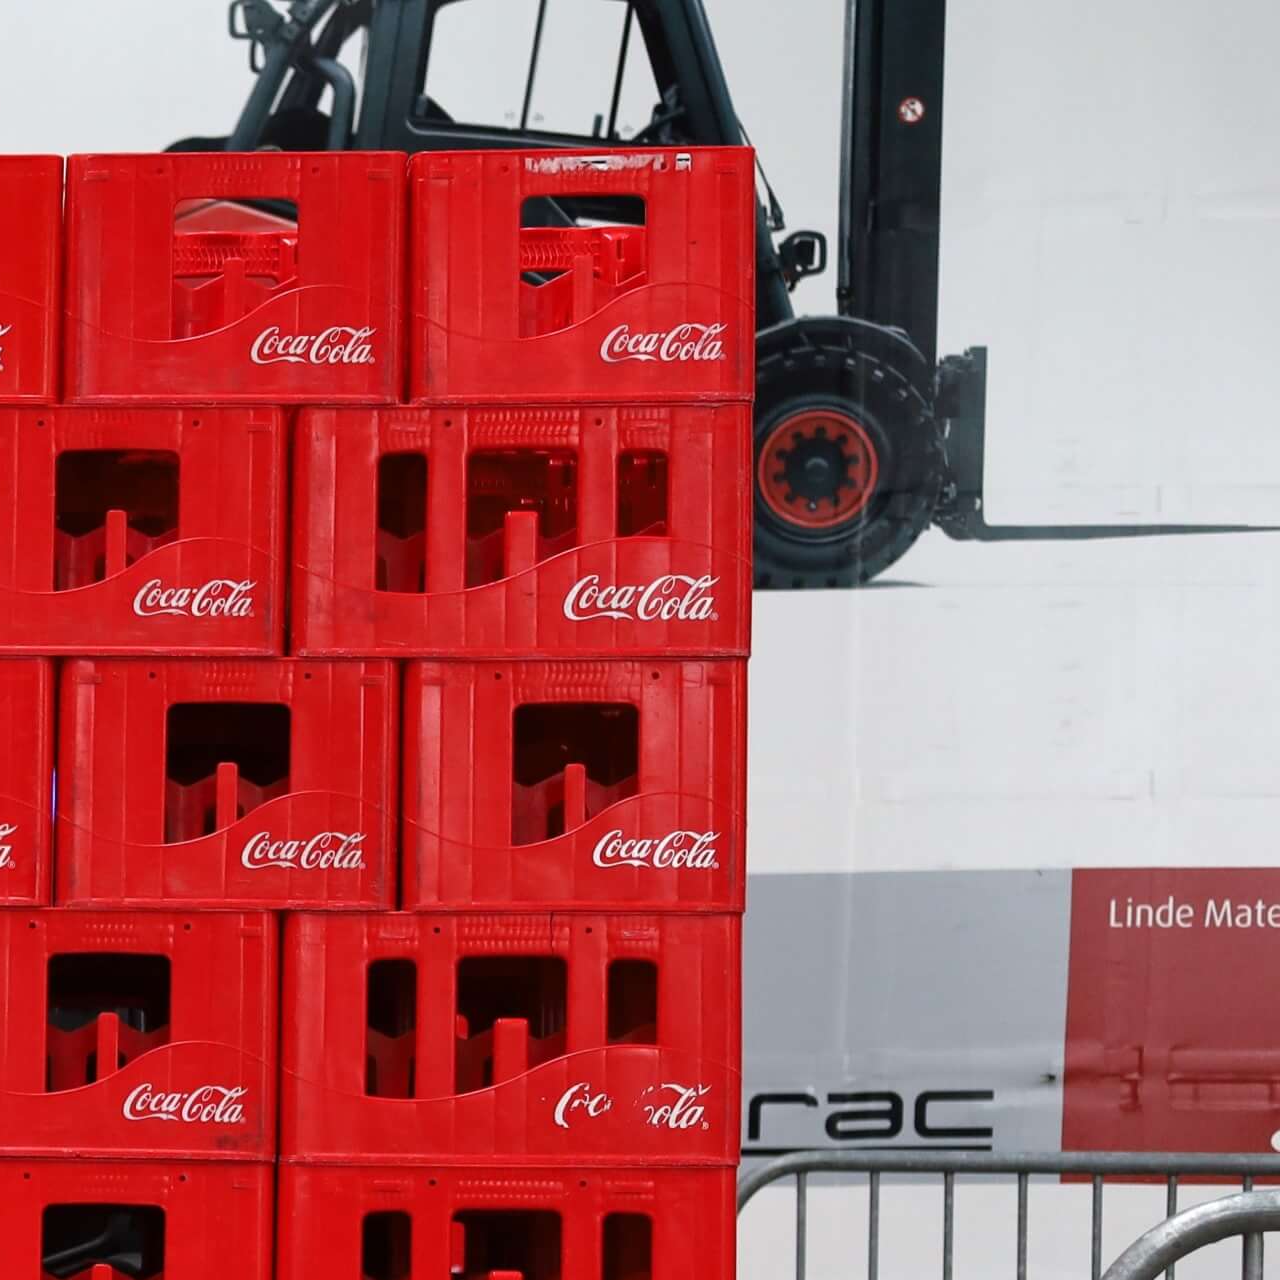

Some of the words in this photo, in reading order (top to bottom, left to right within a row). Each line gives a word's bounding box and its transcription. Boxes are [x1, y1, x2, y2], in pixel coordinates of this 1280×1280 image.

[251, 326, 376, 364] Coca-Cola
[600, 323, 727, 362] Coca-Cola
[133, 579, 256, 617] Coca-Cola
[564, 575, 720, 621] Coca-Cola
[241, 832, 366, 869] Coca-Cola
[593, 830, 721, 869] Coca-Cola
[1109, 895, 1194, 928] Linde
[123, 1083, 248, 1123] Coca-Cola
[747, 1090, 994, 1141] rac
